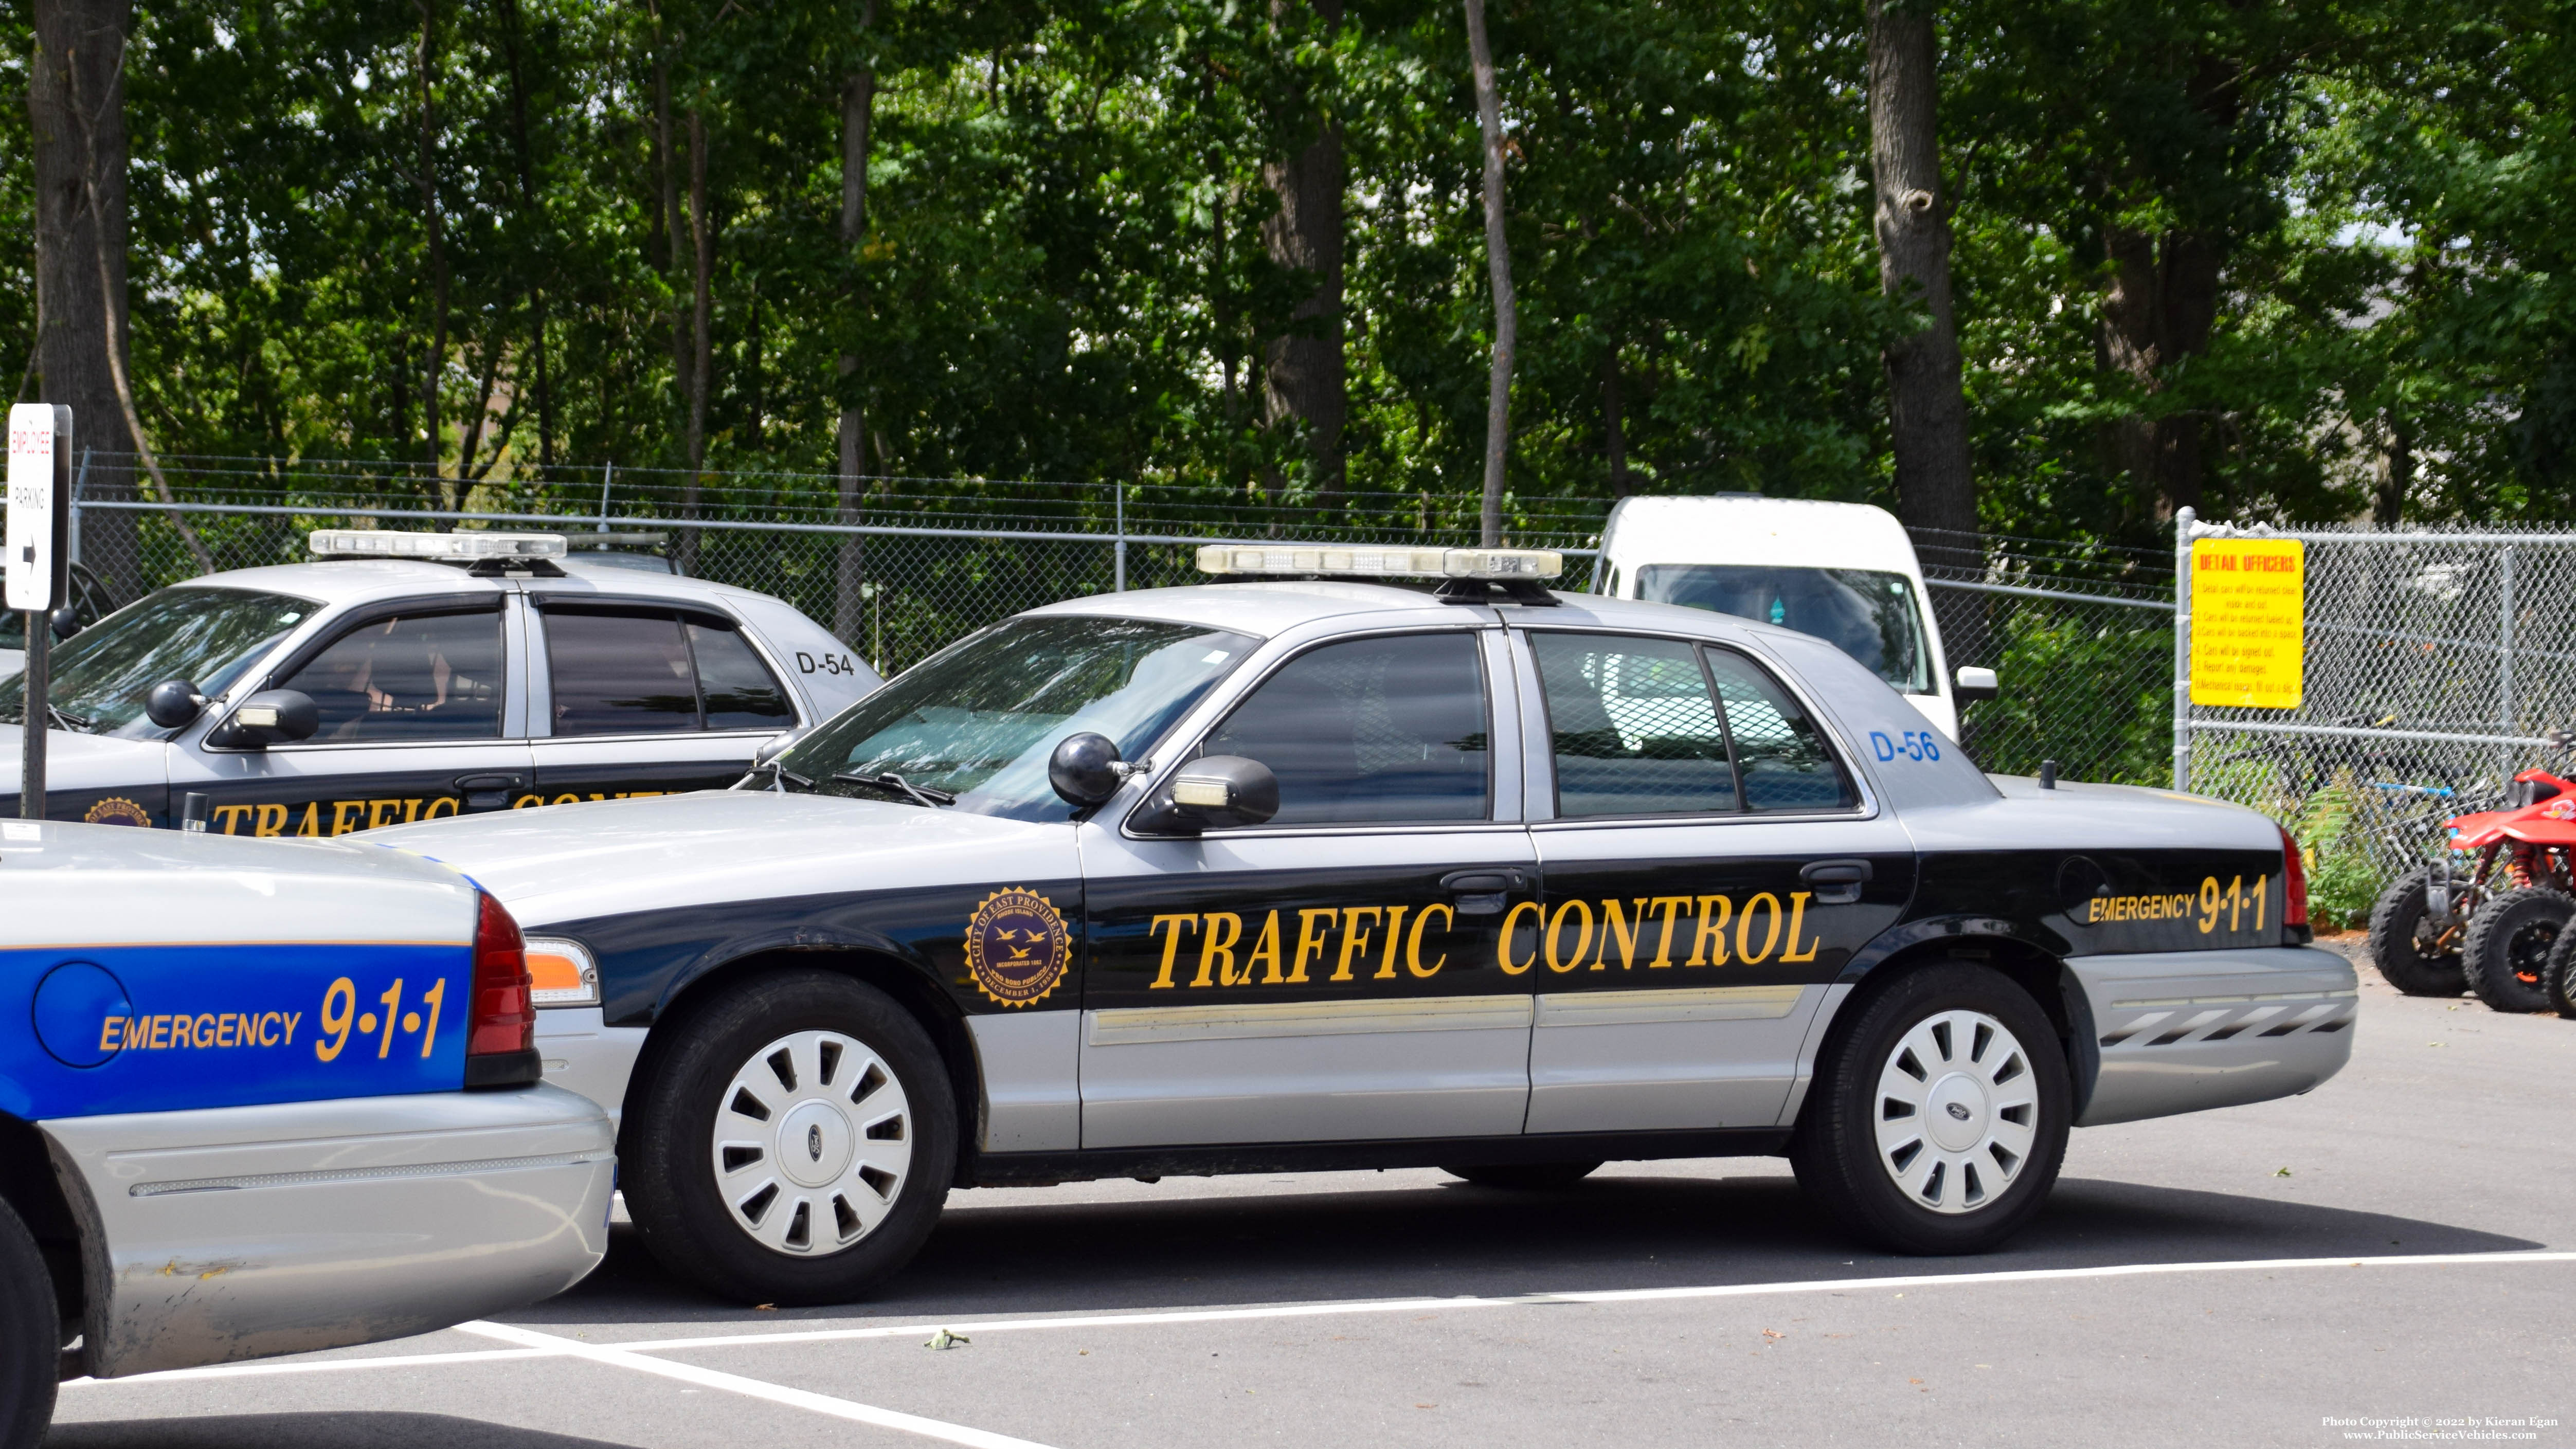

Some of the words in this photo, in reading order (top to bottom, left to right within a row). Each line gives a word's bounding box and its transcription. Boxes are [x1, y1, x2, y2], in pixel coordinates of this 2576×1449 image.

[12, 431, 49, 454] EMPLOYEE
[15, 487, 44, 509] PARKING
[2200, 554, 2239, 571] DETAIL
[2243, 555, 2295, 572] OFFICERS
[2203, 583, 2219, 593] Detail
[2236, 583, 2246, 593] will
[2247, 584, 2254, 593] be
[2256, 584, 2280, 594] returned
[2204, 611, 2218, 622] Cars
[2220, 612, 2229, 622] will
[2240, 613, 2263, 623] returned
[2218, 627, 2226, 637] will
[2228, 627, 2236, 637] be
[2238, 627, 2258, 638] backed
[2260, 628, 2271, 638] into
[2204, 642, 2218, 656] Cars
[2221, 644, 2230, 656] will
[2232, 644, 2239, 656] be
[2242, 645, 2261, 658] signed
[796, 651, 855, 676] D-54
[2204, 660, 2224, 673] Report
[2226, 664, 2236, 674] any
[1869, 731, 1940, 762] D-56
[997, 909, 1014, 919] RHODE
[1015, 909, 1033, 917] ISLAND
[2088, 893, 2195, 922] EMERGENCY
[972, 928, 982, 957] CITY
[978, 911, 990, 927] OF
[988, 896, 1014, 913] EAST
[1018, 896, 1064, 952] PROVIDENCE
[1149, 903, 1454, 989] TRAFFIC
[1498, 891, 1819, 975] CONTROL
[985, 976, 1029, 997] DECEMBER
[1039, 972, 1054, 989] 1958
[991, 969, 1004, 981] PRO
[1005, 977, 1021, 986] BONO
[1022, 966, 1047, 986] PUBLICO
[100, 1012, 302, 1051] EMERGENCY
